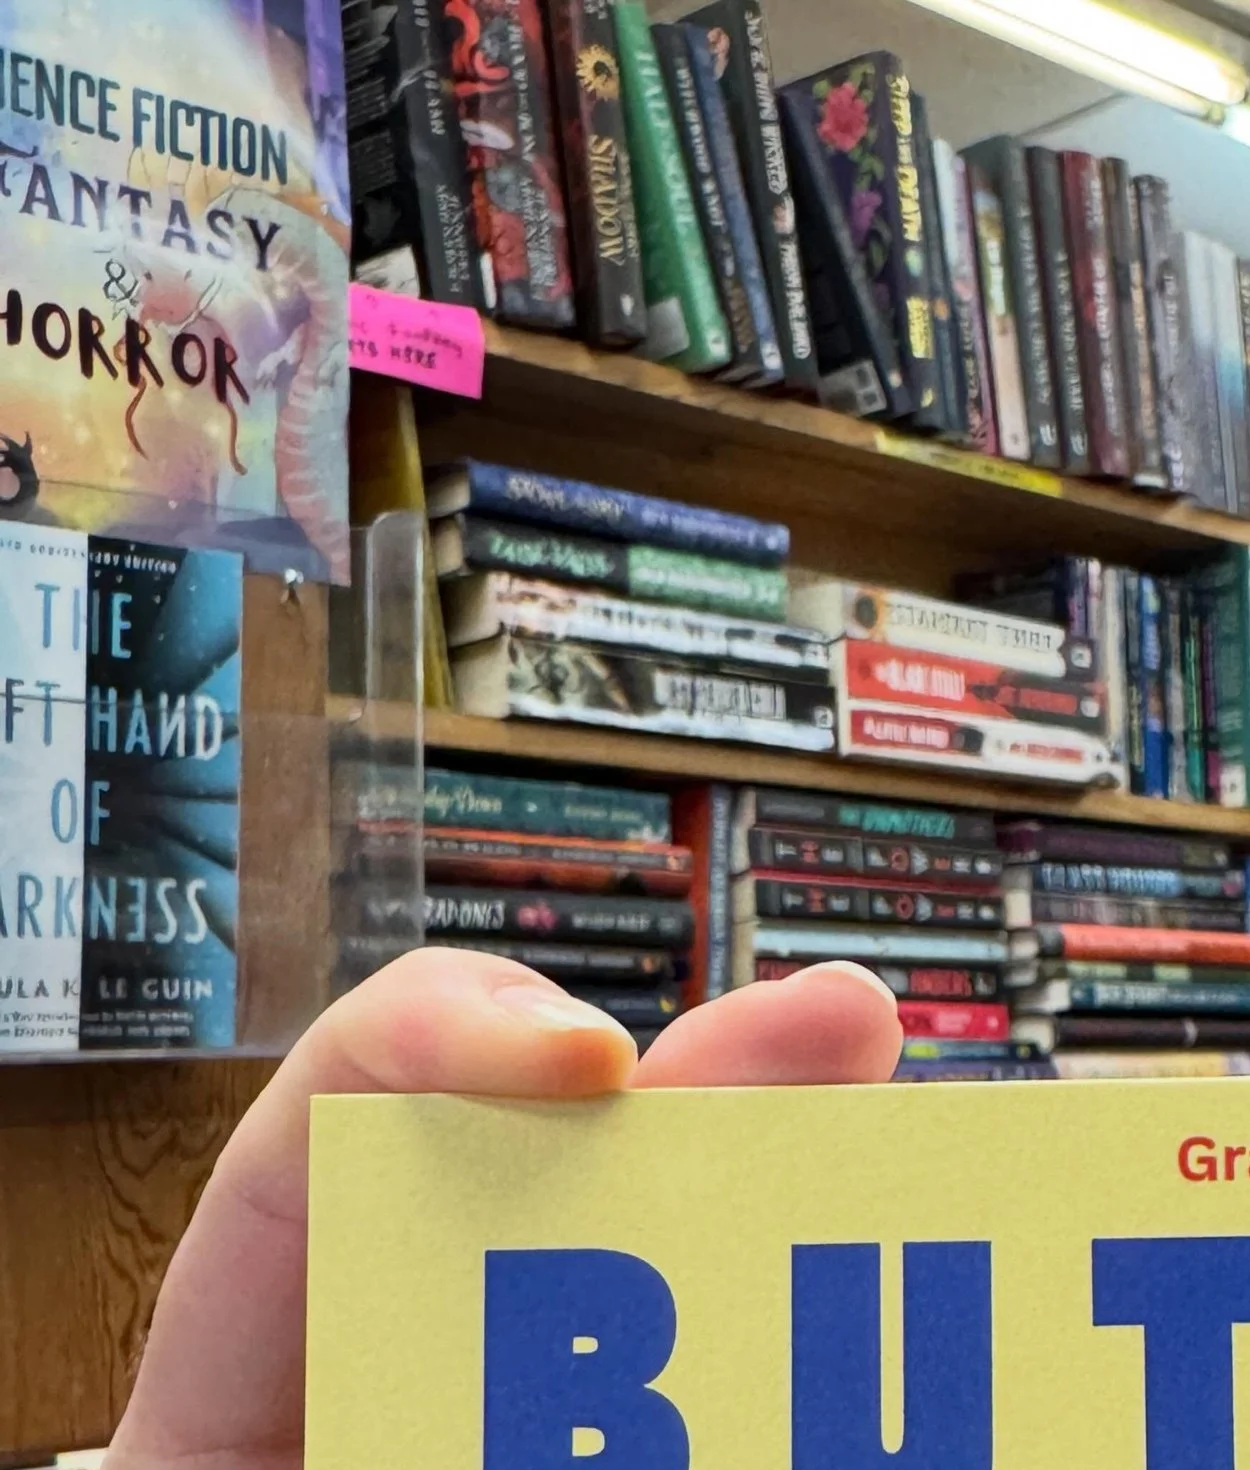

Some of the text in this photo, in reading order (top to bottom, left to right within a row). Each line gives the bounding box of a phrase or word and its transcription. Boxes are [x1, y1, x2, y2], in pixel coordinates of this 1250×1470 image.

[132, 87, 288, 186] FICTION
[588, 134, 627, 267] SHADOW
[102, 258, 139, 301] &
[35, 582, 132, 659] THE
[5, 677, 223, 760] FT HAND
[51, 778, 111, 846] OF
[100, 976, 128, 999] LE
[141, 977, 213, 999] GUIN
